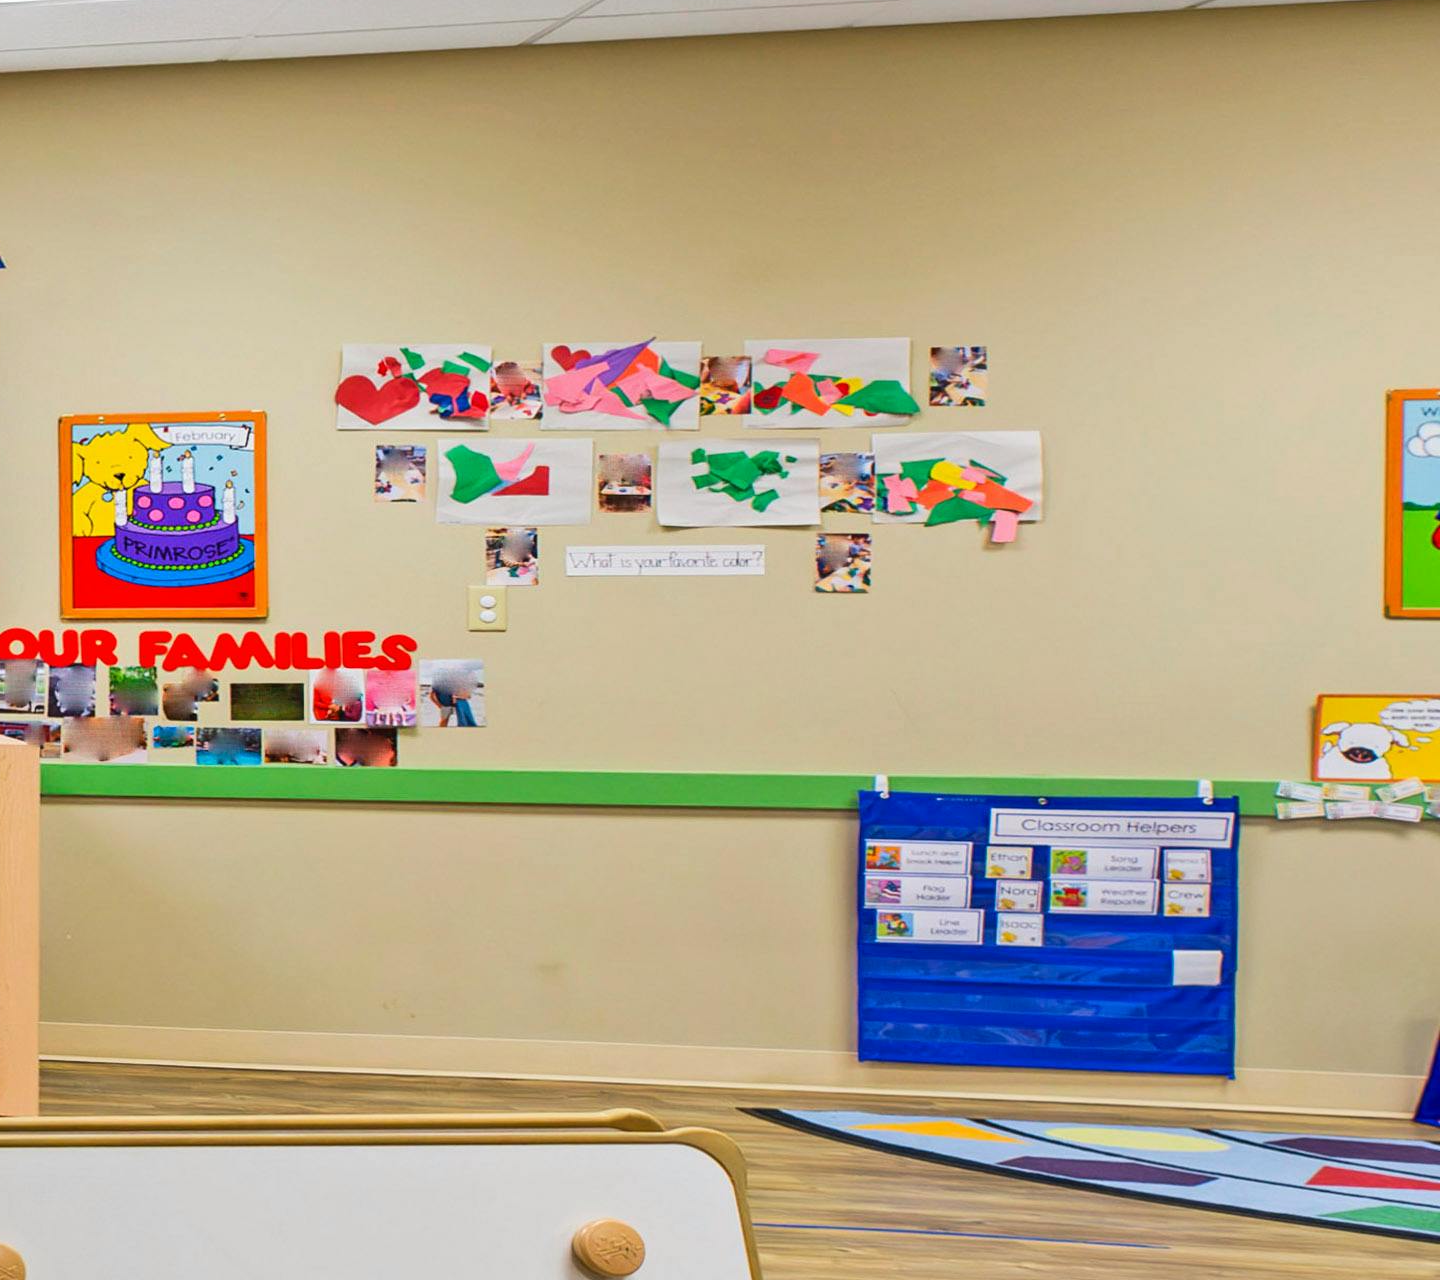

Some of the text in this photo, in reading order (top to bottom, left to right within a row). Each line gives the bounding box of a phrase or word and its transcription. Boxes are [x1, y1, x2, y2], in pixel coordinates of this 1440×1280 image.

[174, 430, 237, 443] February
[568, 551, 613, 569] What
[633, 558, 667, 575] your
[668, 551, 718, 568] favorite
[139, 630, 418, 671] FAMILIES
[1021, 818, 1198, 836] Classroom Helpers
[990, 852, 1028, 862] Ethan
[1000, 886, 1038, 897] Nora
[999, 919, 1038, 930] Isaac
